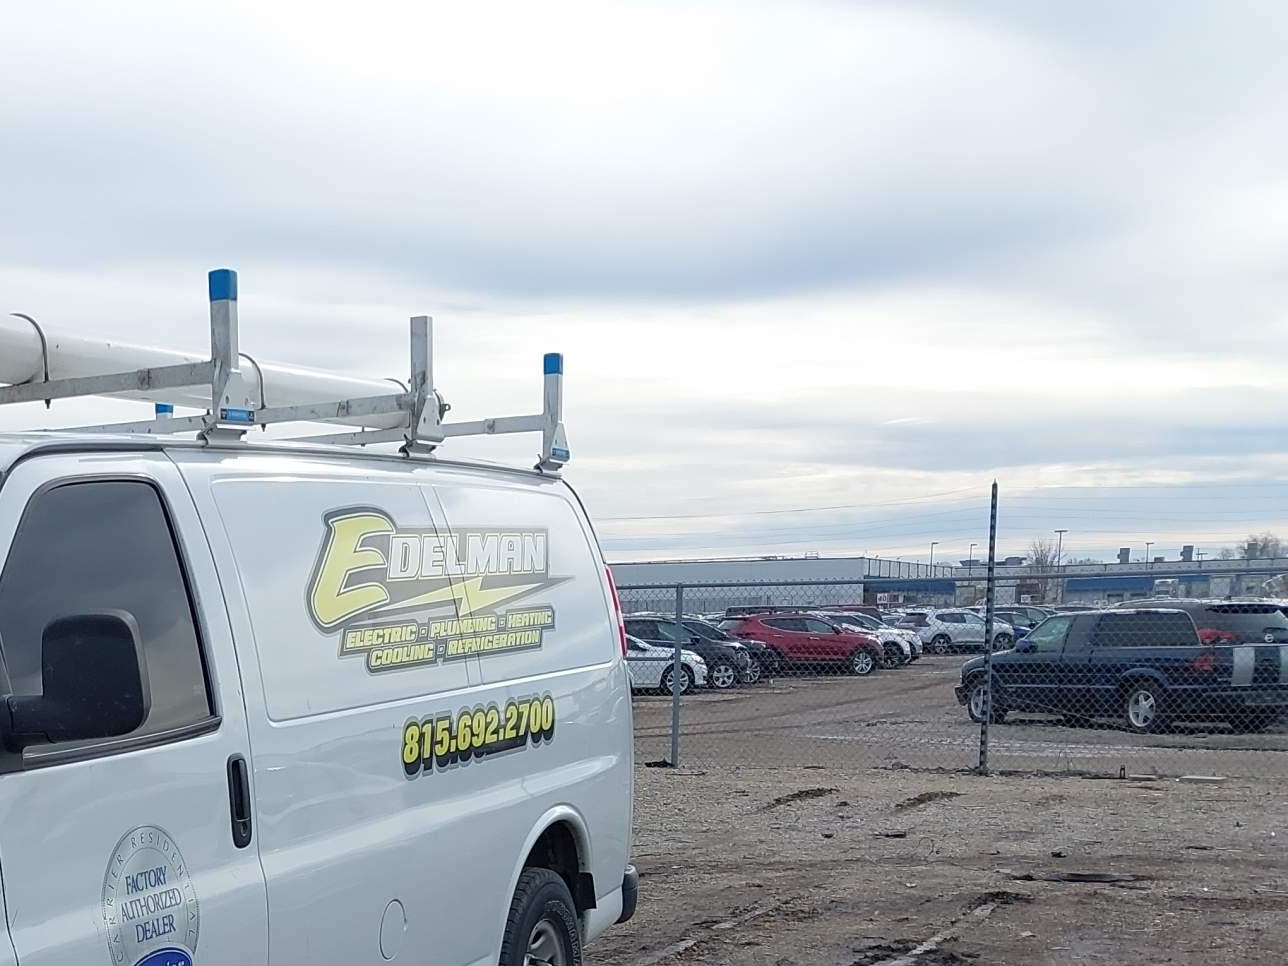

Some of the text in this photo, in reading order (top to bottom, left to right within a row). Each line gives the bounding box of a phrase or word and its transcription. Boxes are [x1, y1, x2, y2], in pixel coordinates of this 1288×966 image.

[312, 511, 547, 628] EDELMAN
[346, 611, 553, 648] ELECTRIC PLUMBING HEATING
[370, 629, 541, 667] COOLING REFRIGERATION
[402, 697, 554, 768] 815.692.2700
[125, 865, 168, 895] FACTORY
[121, 887, 182, 923] AUTHORIZED
[136, 914, 176, 943] DEALER
